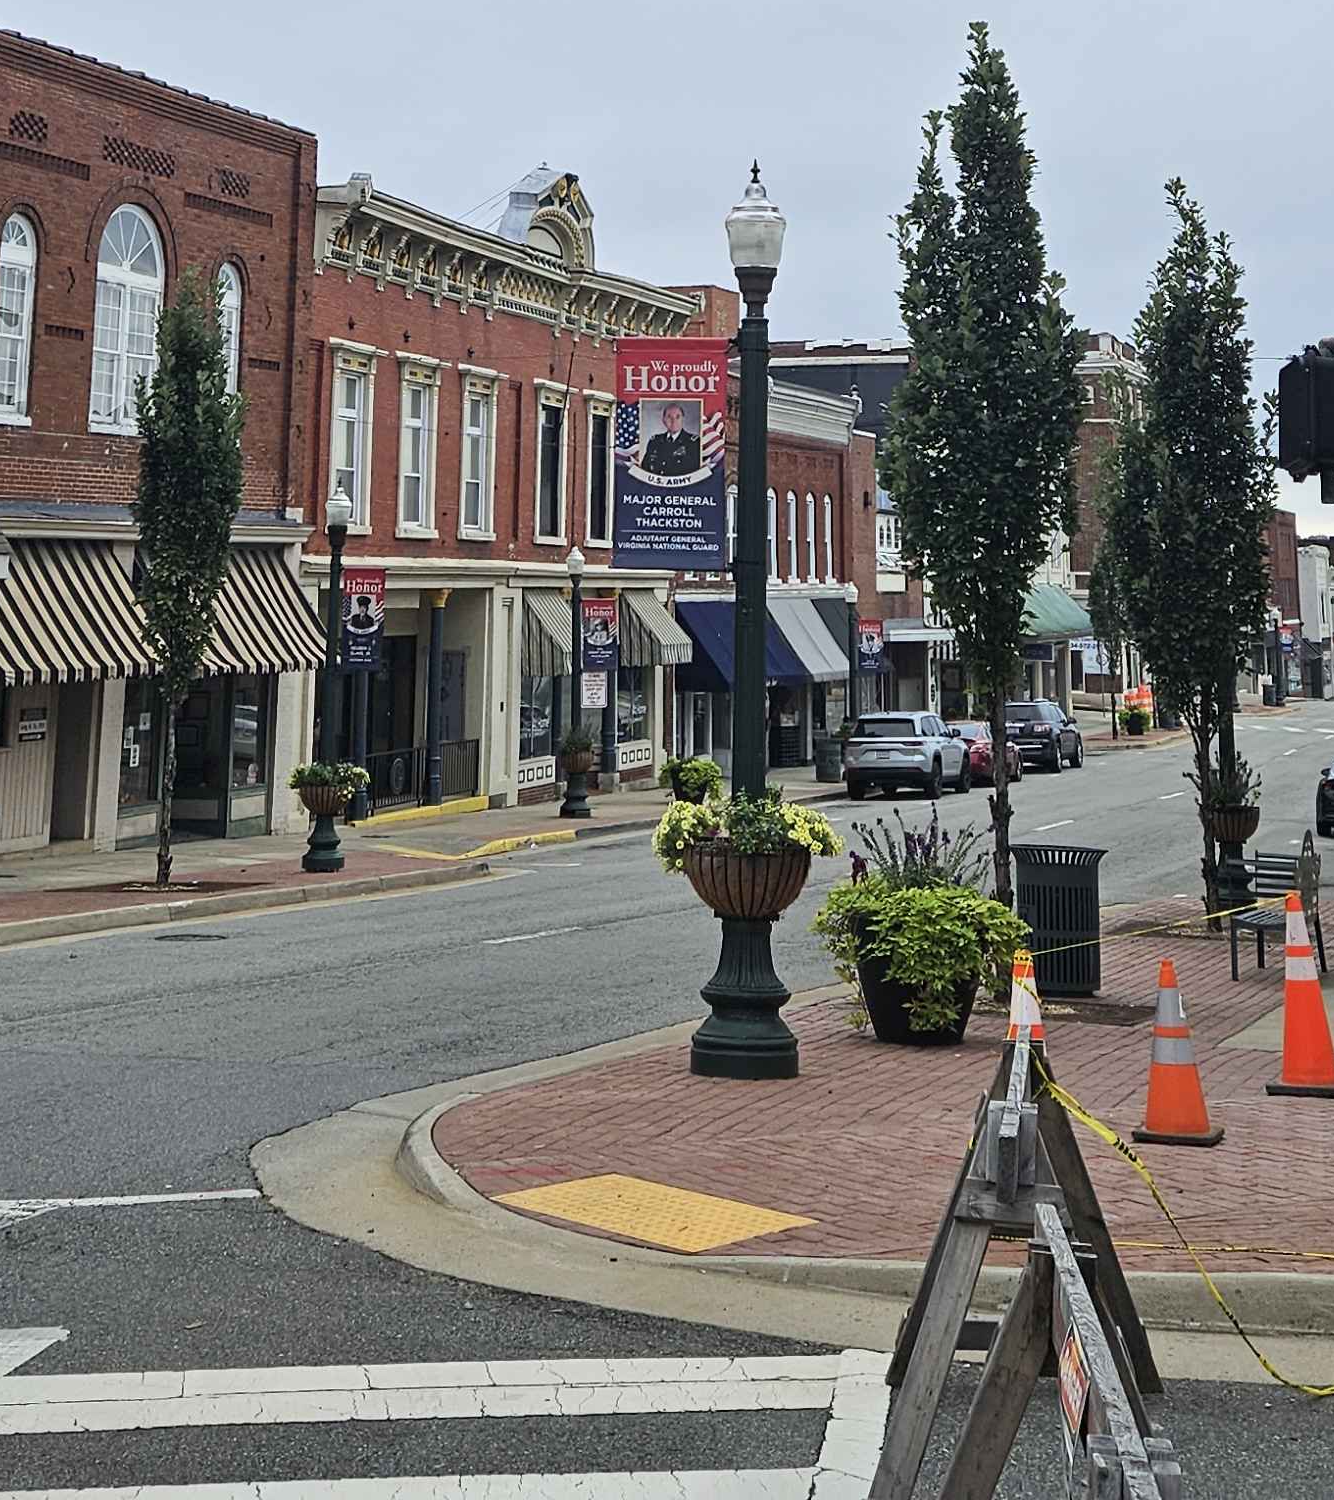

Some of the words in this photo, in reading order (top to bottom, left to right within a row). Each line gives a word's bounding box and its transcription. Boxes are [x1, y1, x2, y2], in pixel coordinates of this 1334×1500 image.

[651, 360, 669, 371] We
[672, 360, 719, 375] proudly
[623, 365, 720, 392] Honor
[648, 475, 664, 485] U.S.
[667, 476, 692, 486] ARMY
[623, 494, 662, 505] MAJOR
[664, 496, 717, 506] GENERAL
[643, 506, 696, 517] CARROLL
[635, 518, 703, 528] THACKSTON
[652, 543, 691, 551] NATIONAL
[347, 579, 383, 593] Honor
[585, 607, 614, 618] Honor
